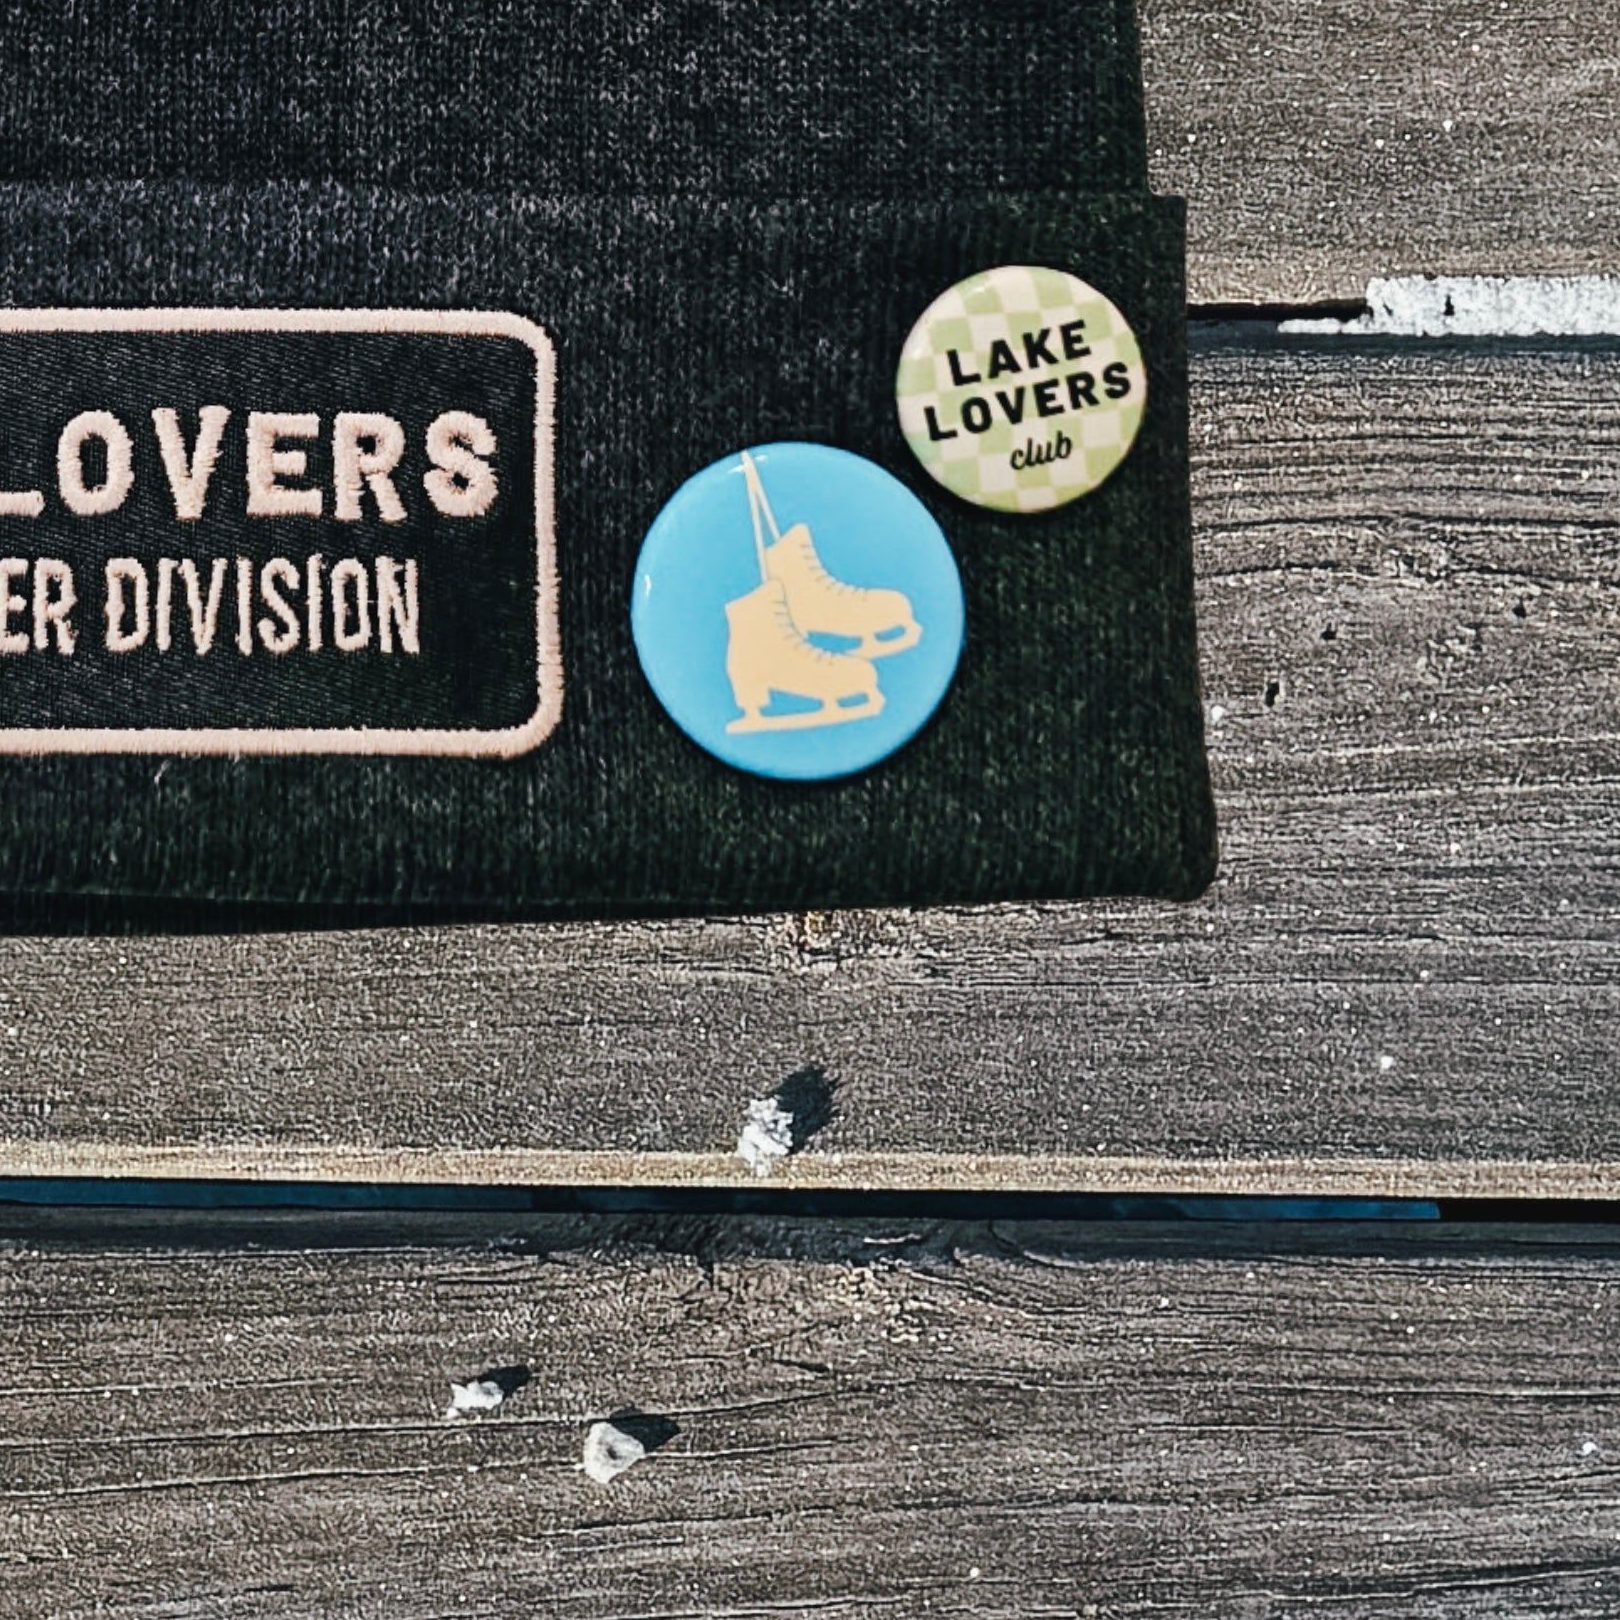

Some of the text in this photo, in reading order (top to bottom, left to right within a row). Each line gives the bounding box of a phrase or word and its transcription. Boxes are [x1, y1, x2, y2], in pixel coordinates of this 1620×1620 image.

[946, 319, 1091, 387] LAKE
[923, 361, 1132, 442] LOVERS
[1009, 430, 1072, 470] club
[104, 553, 422, 657] DIVISION
